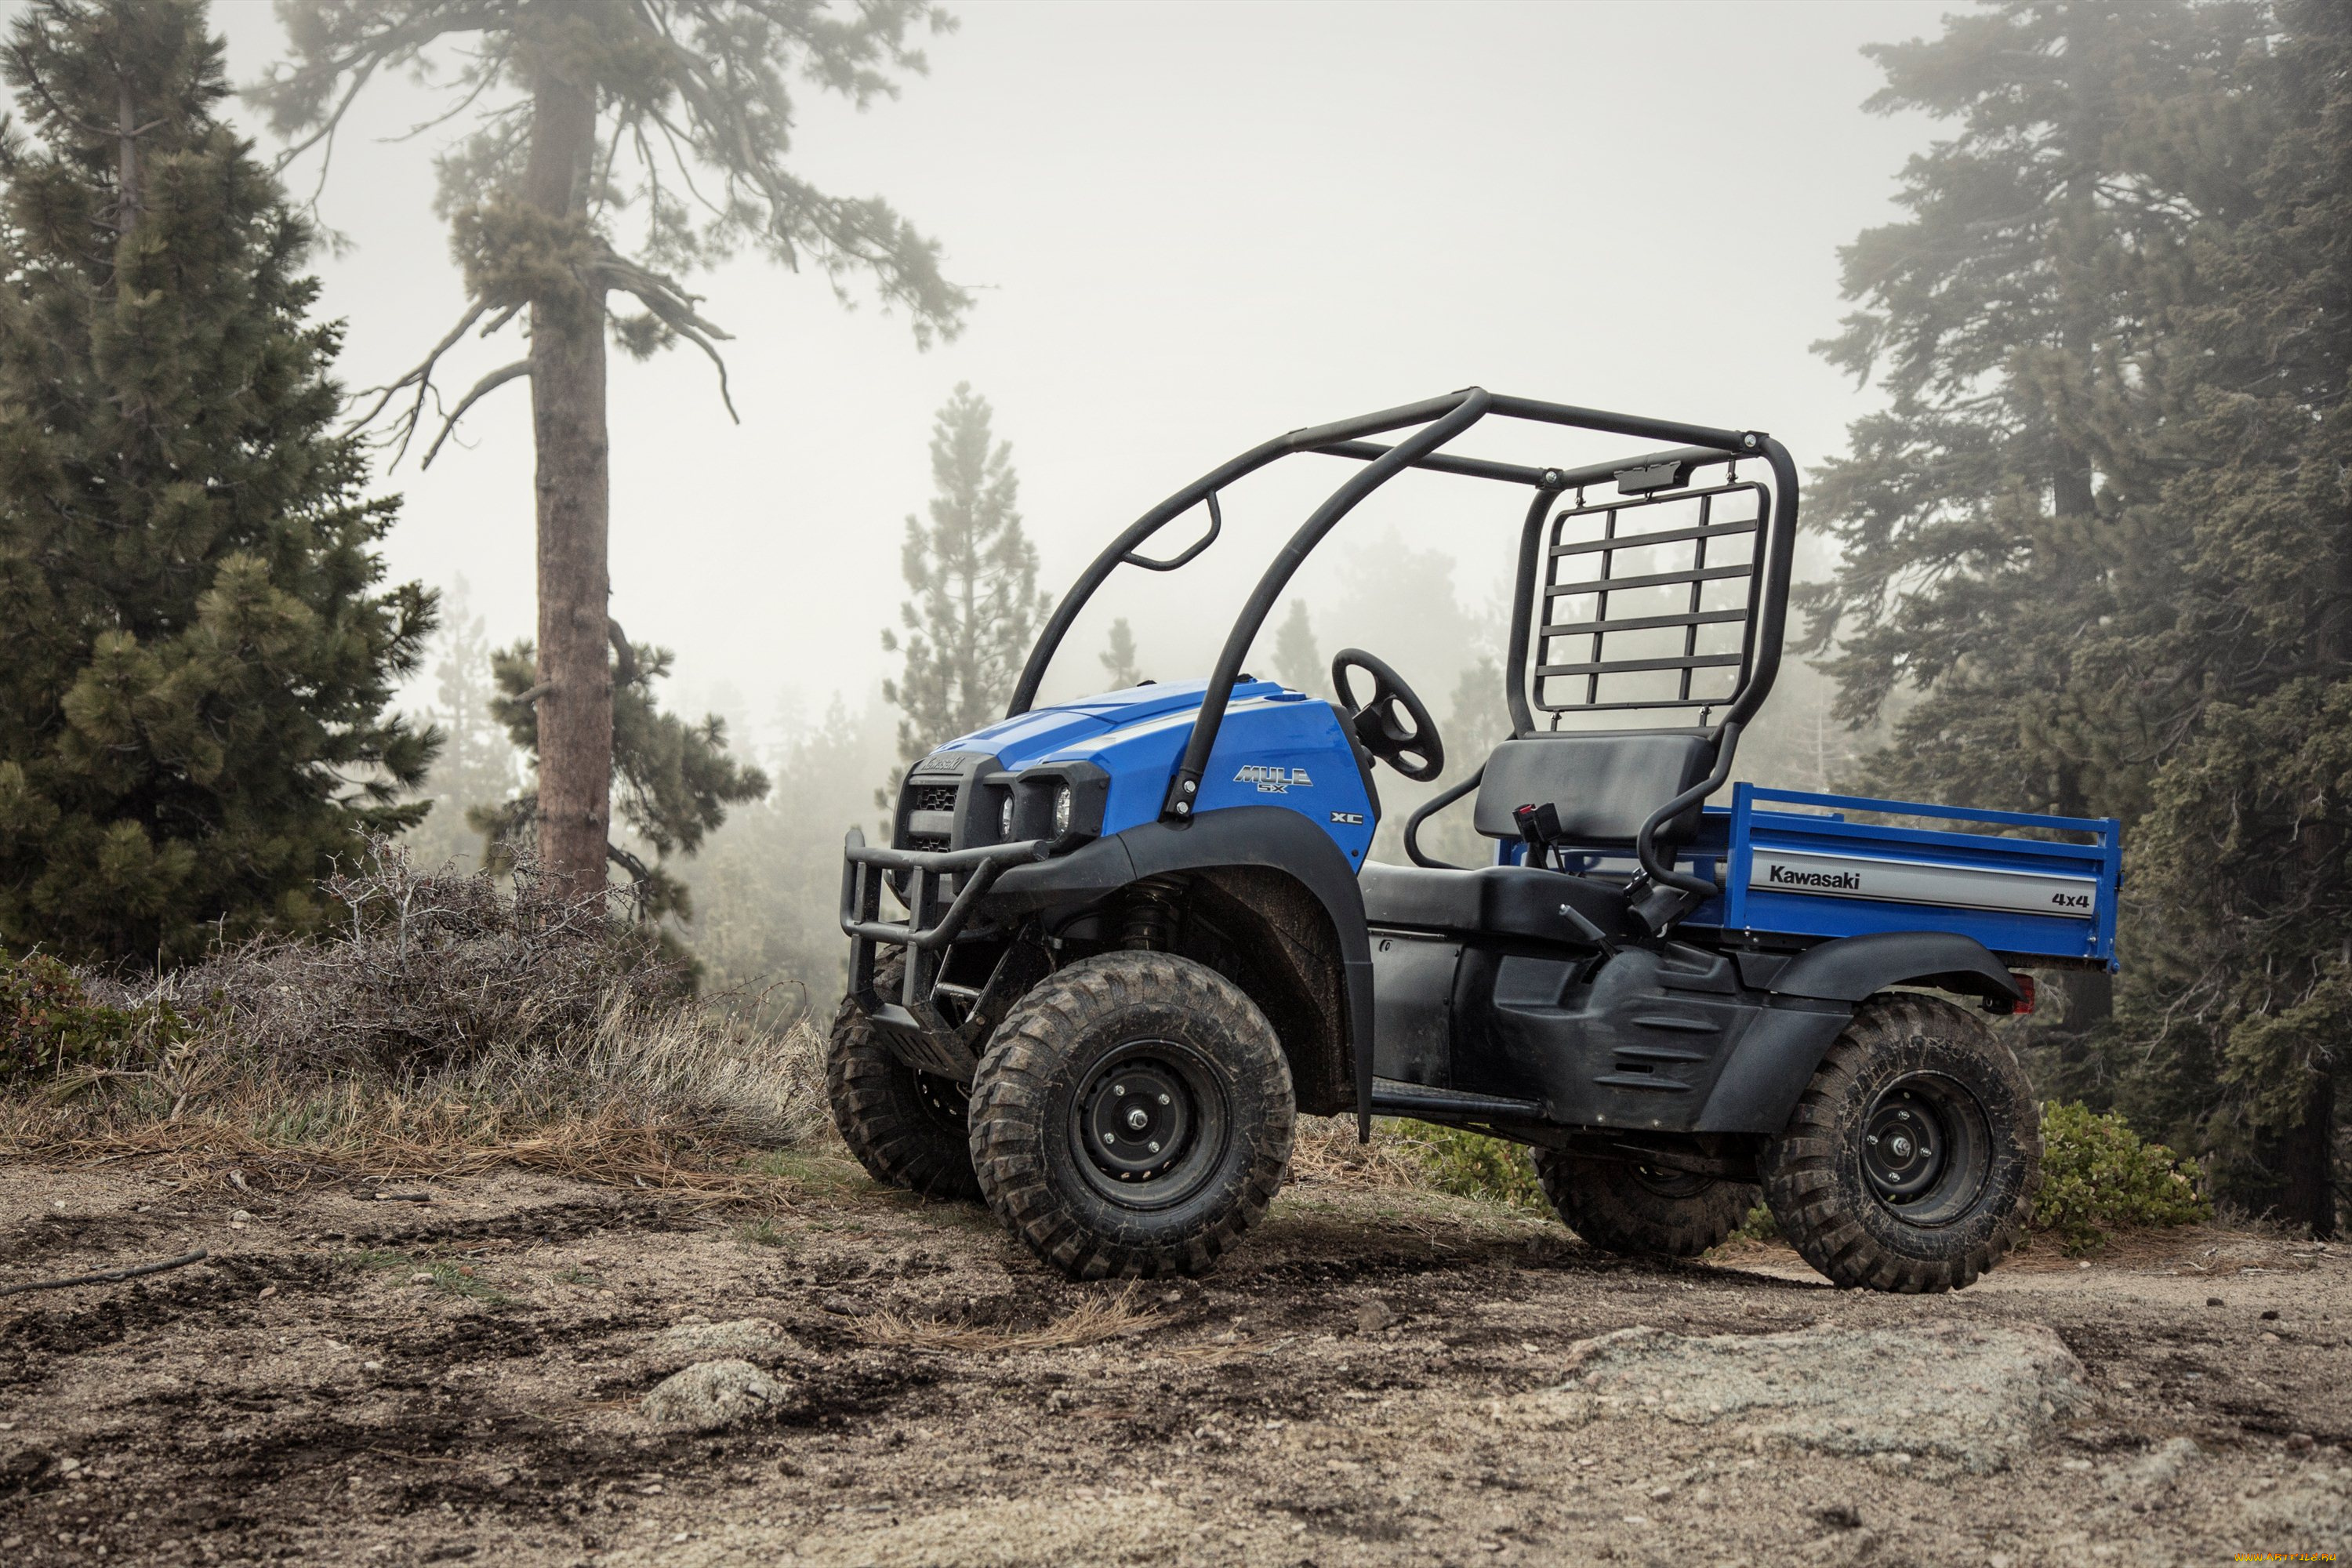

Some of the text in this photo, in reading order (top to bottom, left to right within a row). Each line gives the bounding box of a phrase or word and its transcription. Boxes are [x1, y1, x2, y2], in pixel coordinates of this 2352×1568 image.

[1233, 765, 1313, 786] MULE
[1258, 783, 1288, 793] SX
[1331, 811, 1363, 824] XC
[1769, 865, 1860, 890] Kawasaki
[2052, 893, 2089, 908] 4x4
